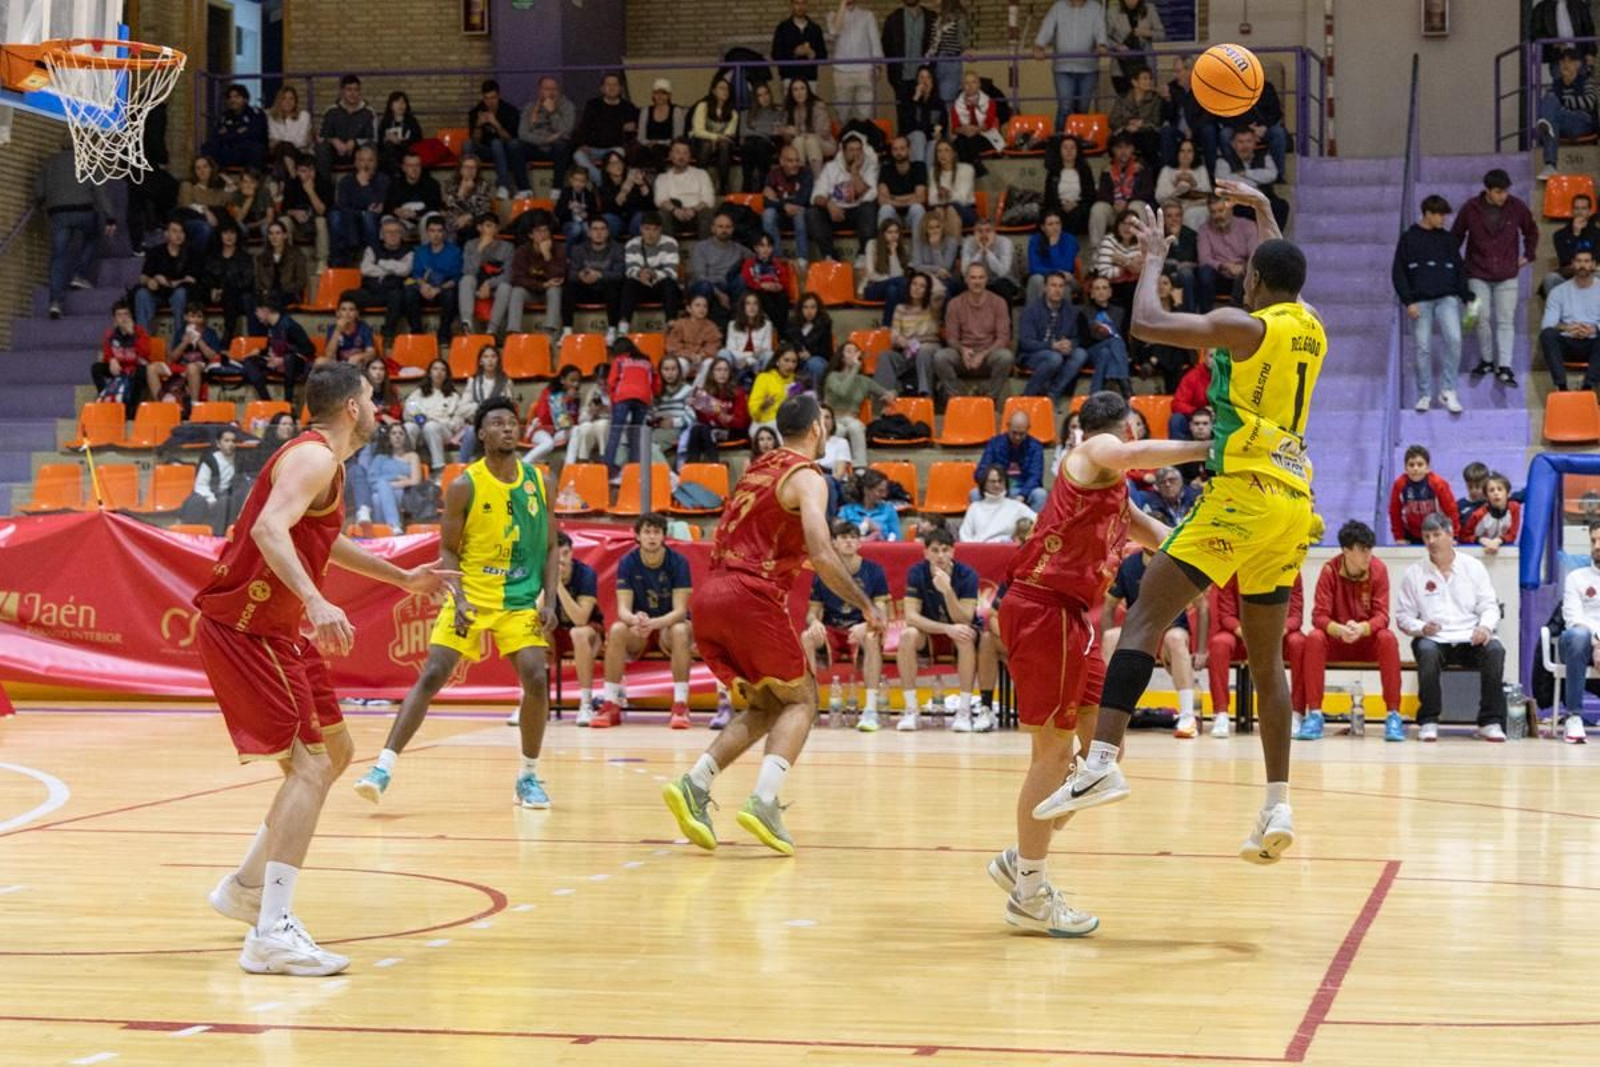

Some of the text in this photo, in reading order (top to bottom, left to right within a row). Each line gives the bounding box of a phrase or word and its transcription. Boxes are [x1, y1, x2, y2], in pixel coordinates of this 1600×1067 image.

[1251, 361, 1272, 406] RUSTER
[1290, 361, 1308, 433] 1
[23, 593, 96, 629] Jaén
